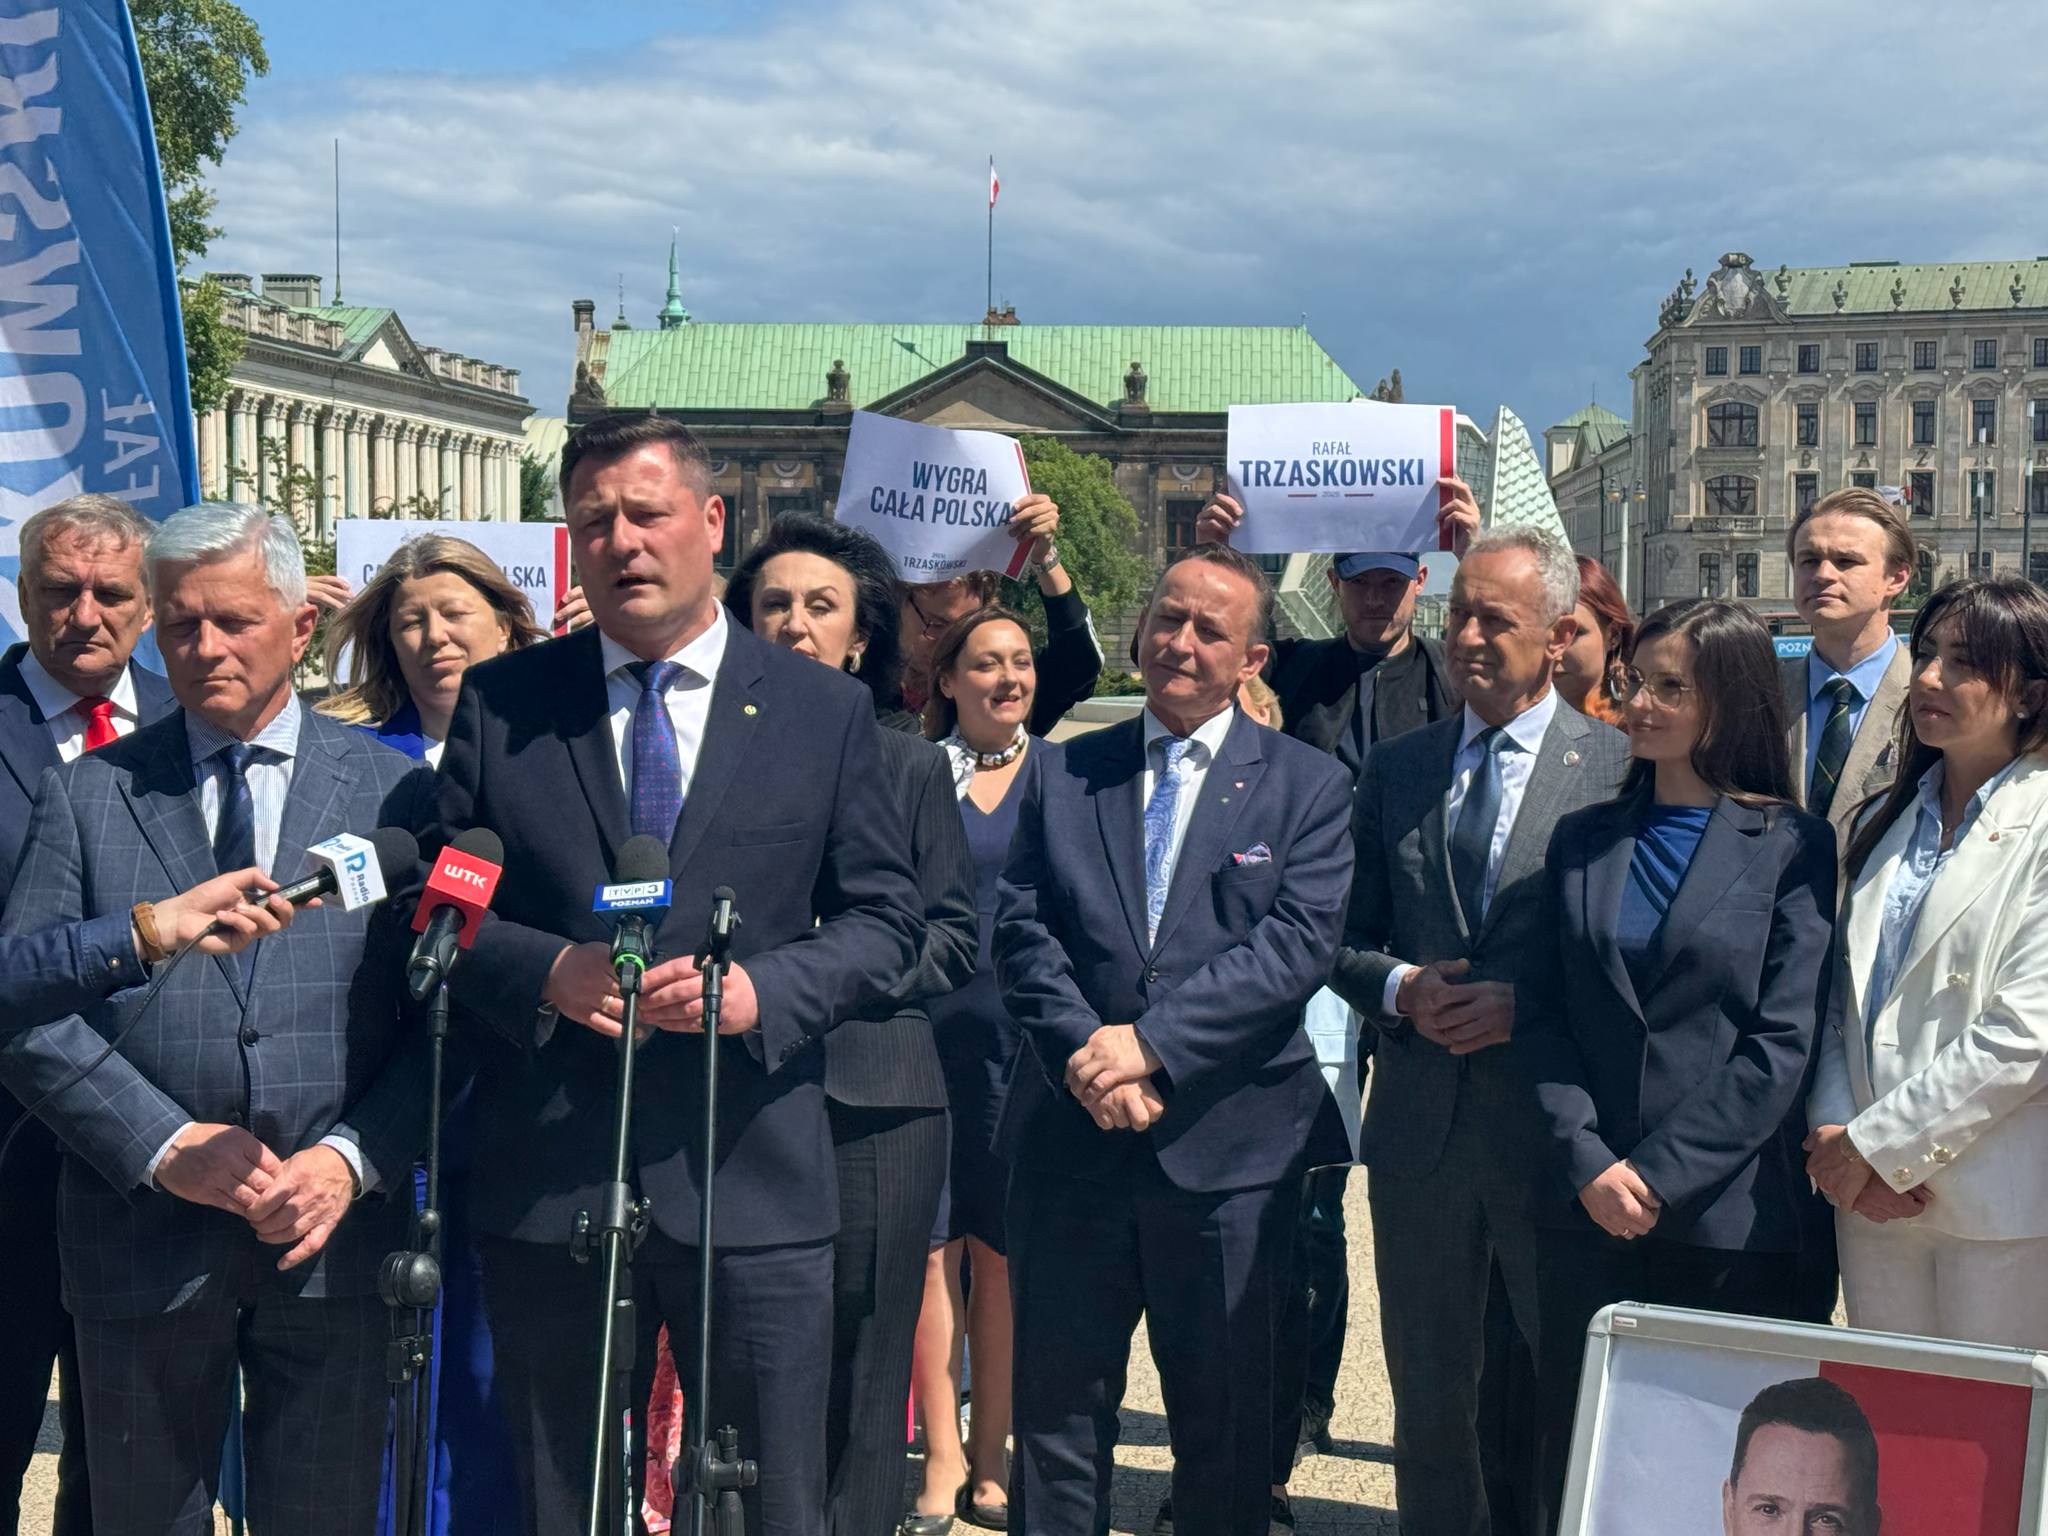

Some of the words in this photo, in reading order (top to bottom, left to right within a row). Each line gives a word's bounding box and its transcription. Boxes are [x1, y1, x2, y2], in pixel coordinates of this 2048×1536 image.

[1312, 441, 1352, 456] RAFAŁ
[912, 461, 987, 496] WYGRA
[1239, 459, 1424, 487] TRZASKOWSKI
[870, 486, 924, 523] CAŁA
[931, 497, 1011, 528] POLSKA
[356, 873, 370, 903] Radio
[444, 864, 488, 889] WTK
[610, 897, 655, 907] POZNAŃ
[611, 887, 644, 896] TVP
[647, 884, 659, 894] 3
